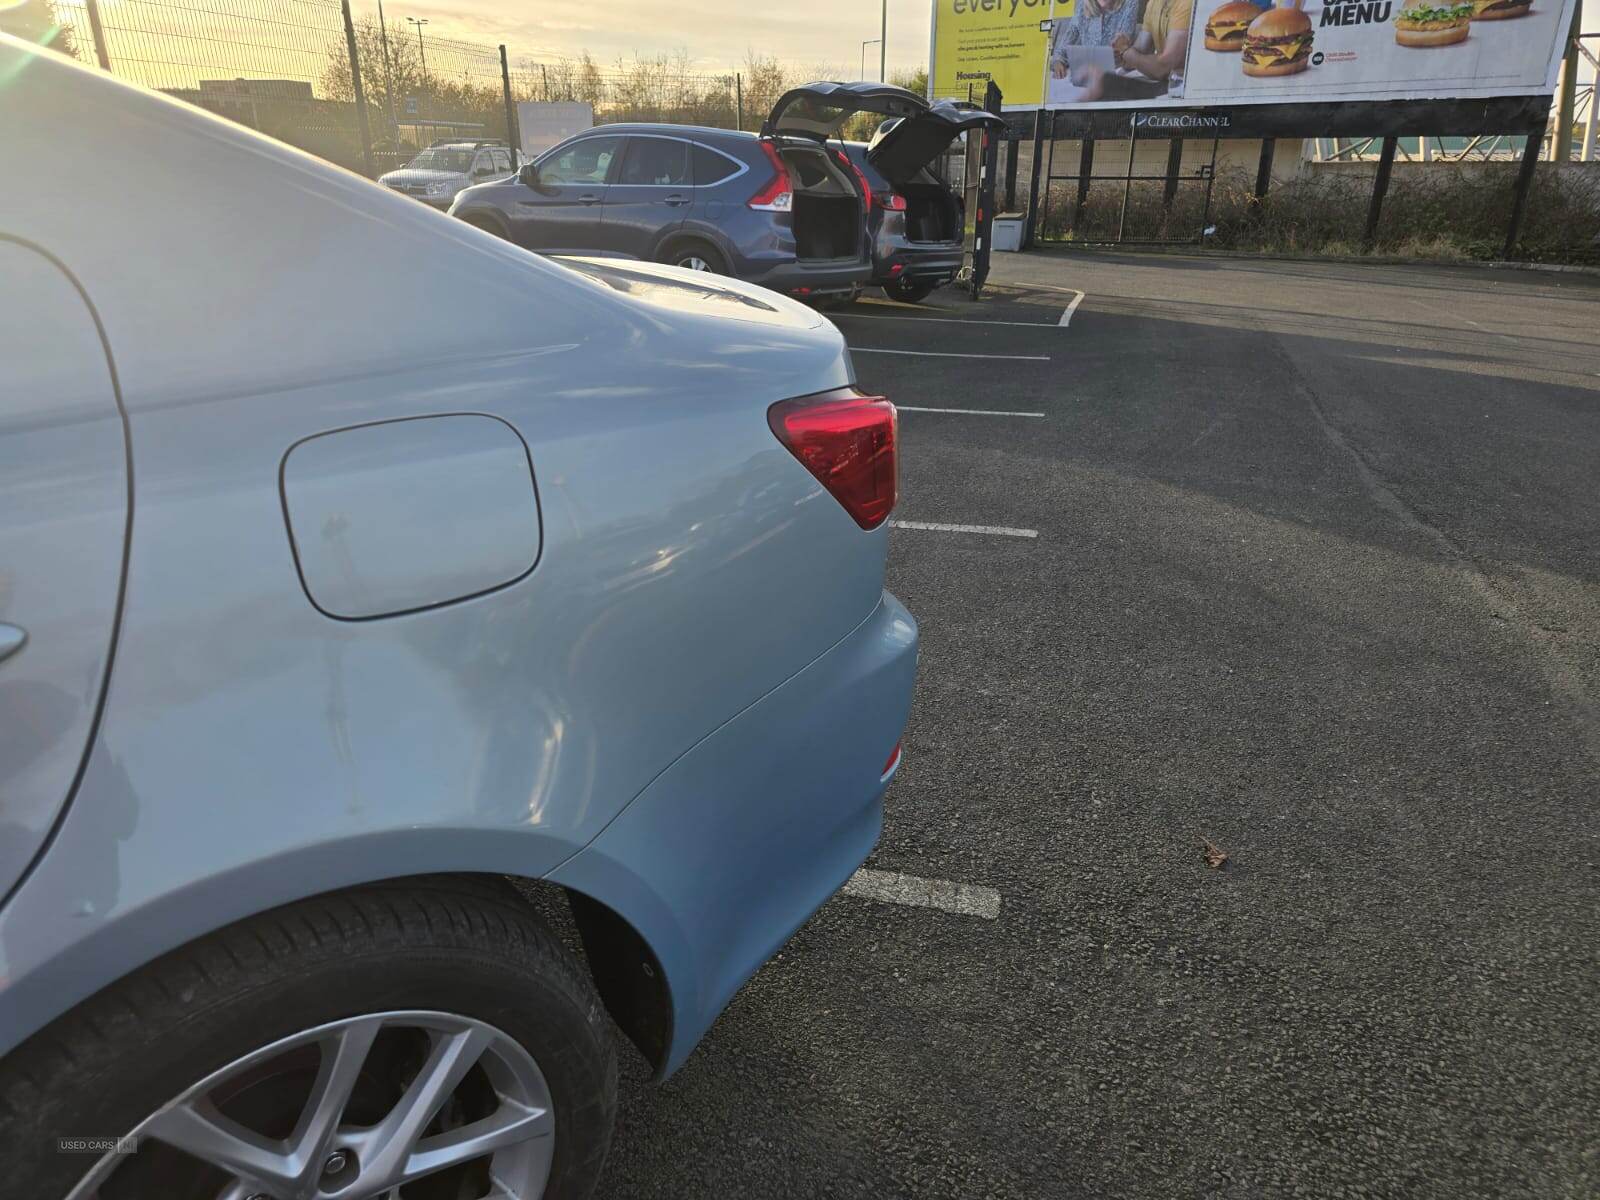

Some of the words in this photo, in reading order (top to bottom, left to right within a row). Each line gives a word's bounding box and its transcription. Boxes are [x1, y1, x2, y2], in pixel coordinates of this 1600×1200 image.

[953, 0, 1070, 17] every
[1319, 1, 1392, 27] MENU
[956, 70, 991, 81] Housing
[956, 81, 987, 89] Exeutiv
